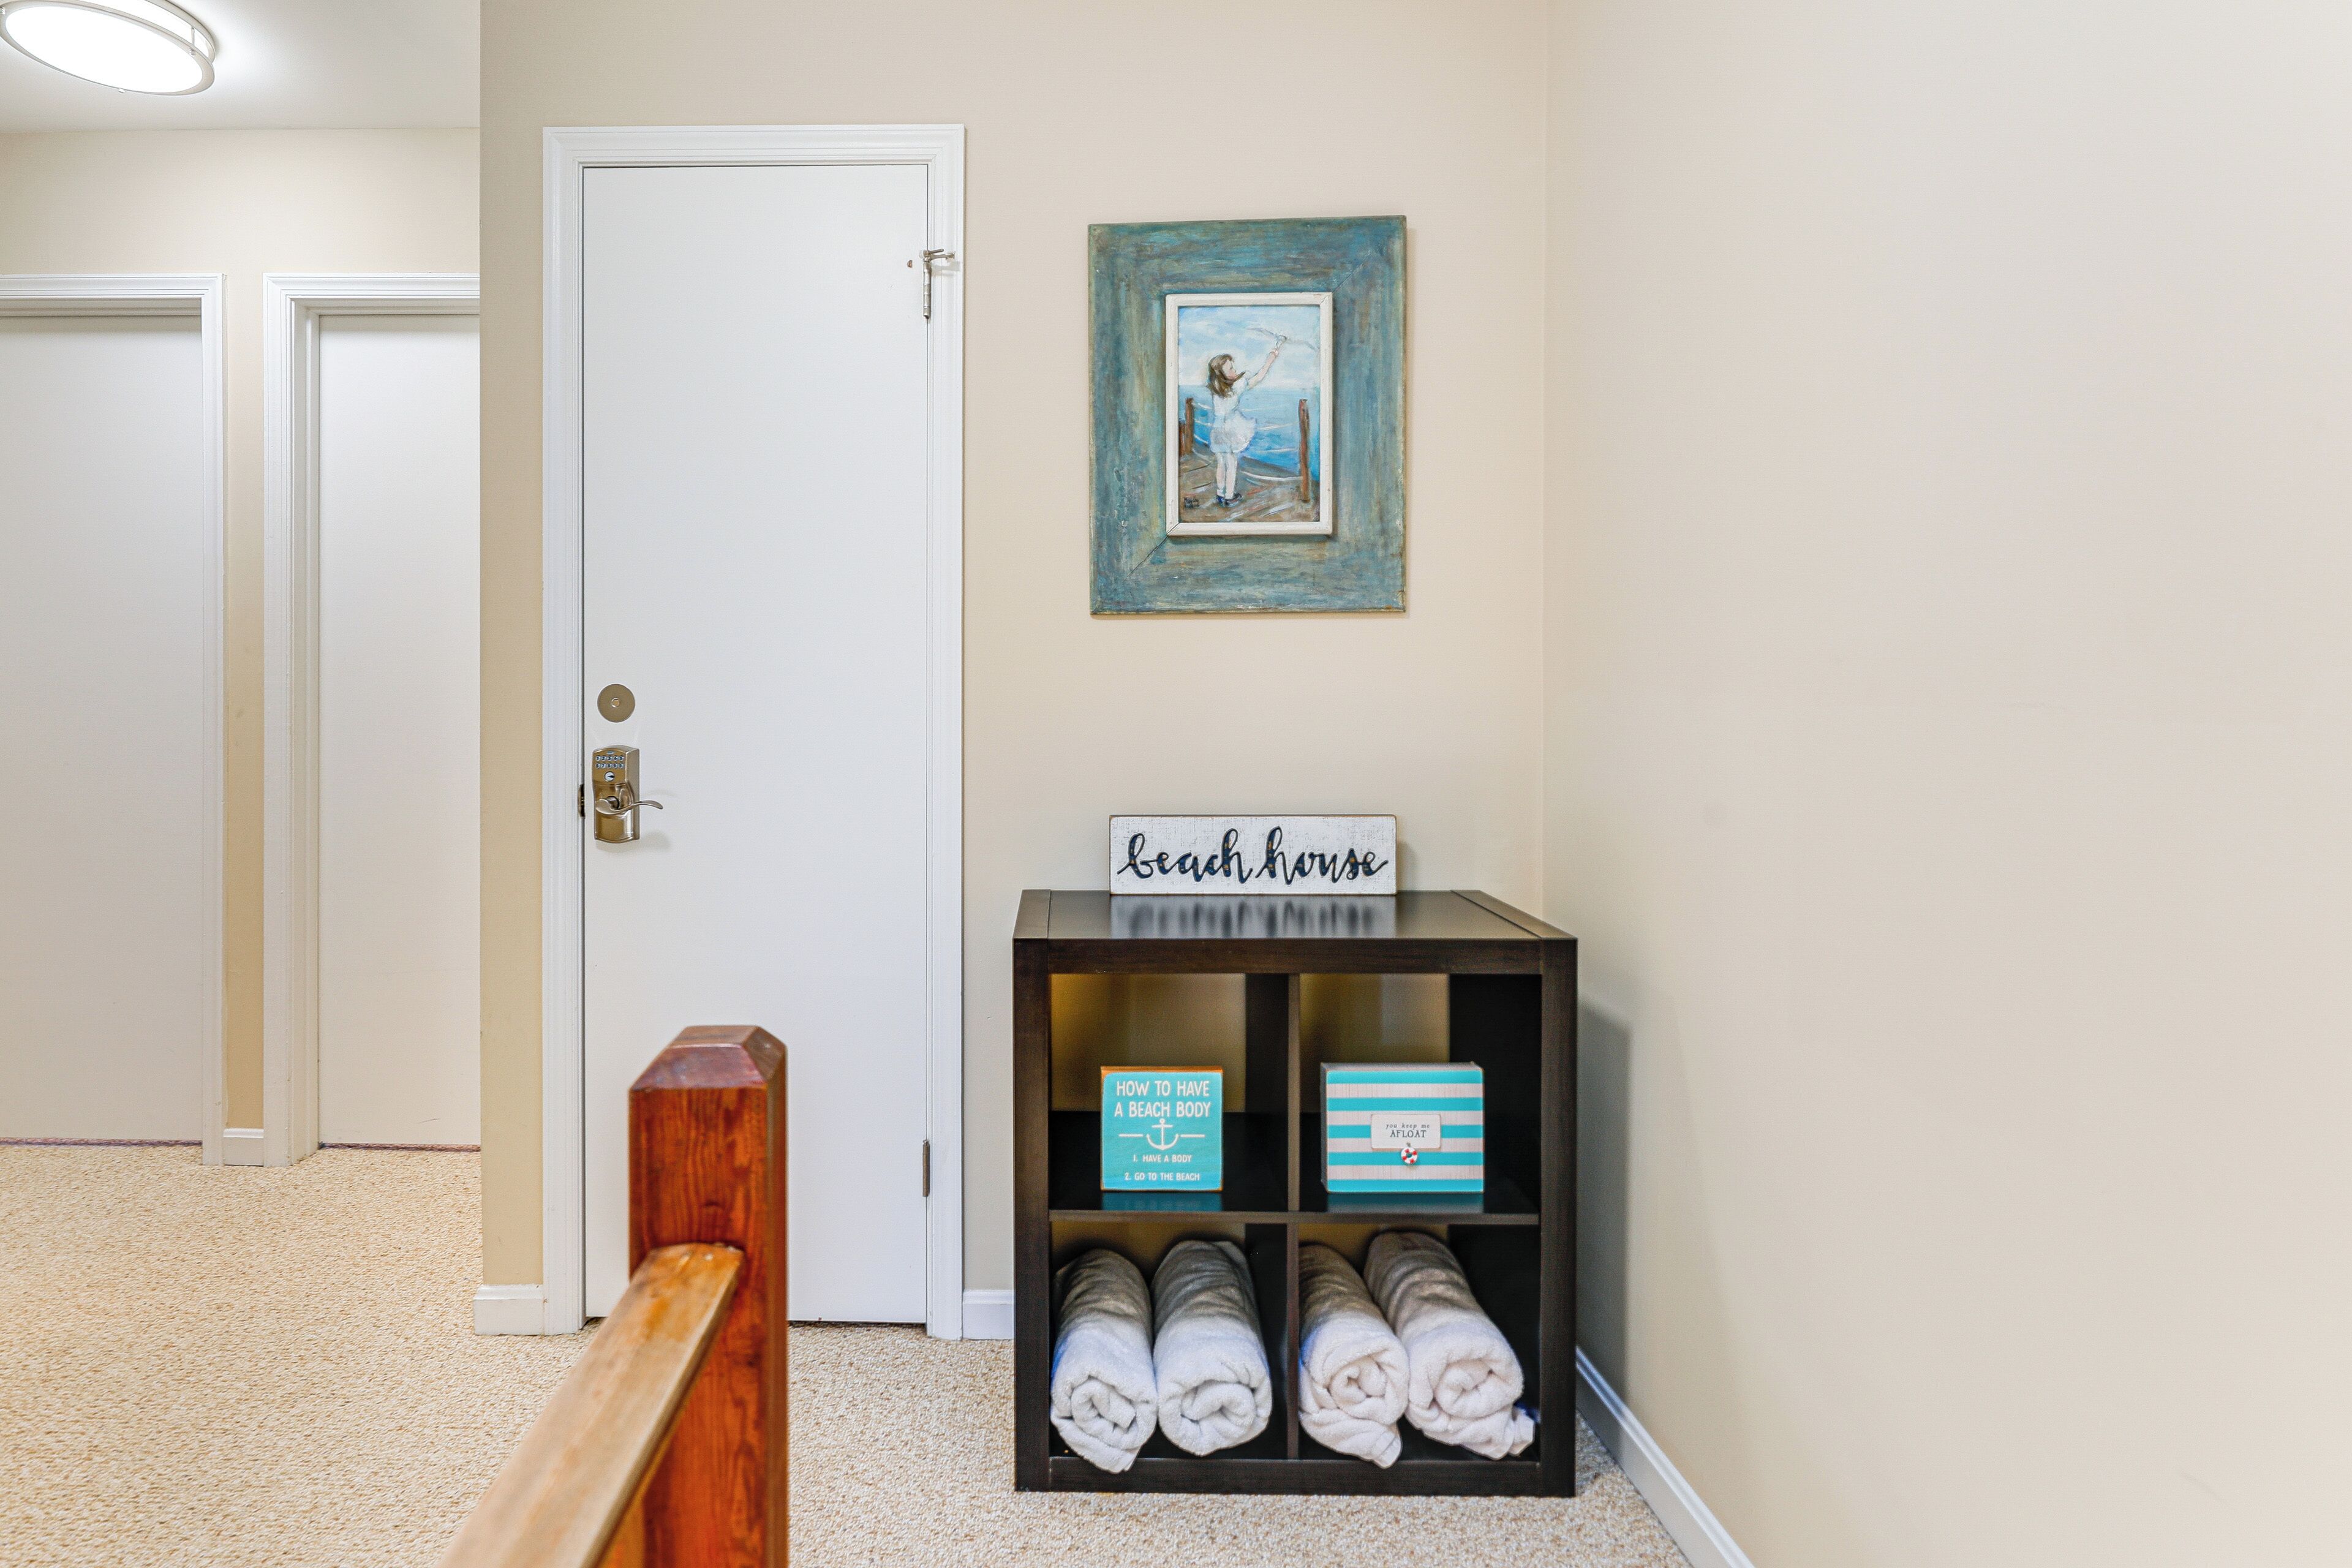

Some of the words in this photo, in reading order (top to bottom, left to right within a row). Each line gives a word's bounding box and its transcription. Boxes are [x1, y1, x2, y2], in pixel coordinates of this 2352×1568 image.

[1117, 827, 1253, 884] beach
[1255, 826, 1389, 885] house
[1117, 1080, 1150, 1096] HOW
[1155, 1080, 1170, 1096] TO
[1177, 1080, 1210, 1096] HAVE
[1114, 1101, 1123, 1117] A
[1129, 1101, 1170, 1117] BEACH
[1176, 1101, 1211, 1117] BODY
[1390, 1129, 1427, 1138] AFLOAT
[1133, 1154, 1138, 1163] 1.
[1142, 1154, 1162, 1163] HAVE
[1172, 1154, 1192, 1163] BODY
[1125, 1172, 1131, 1181] 2.
[1134, 1172, 1145, 1181] GO
[1148, 1172, 1157, 1181] TO
[1160, 1172, 1174, 1181] THE
[1176, 1172, 1200, 1181] BEACH
